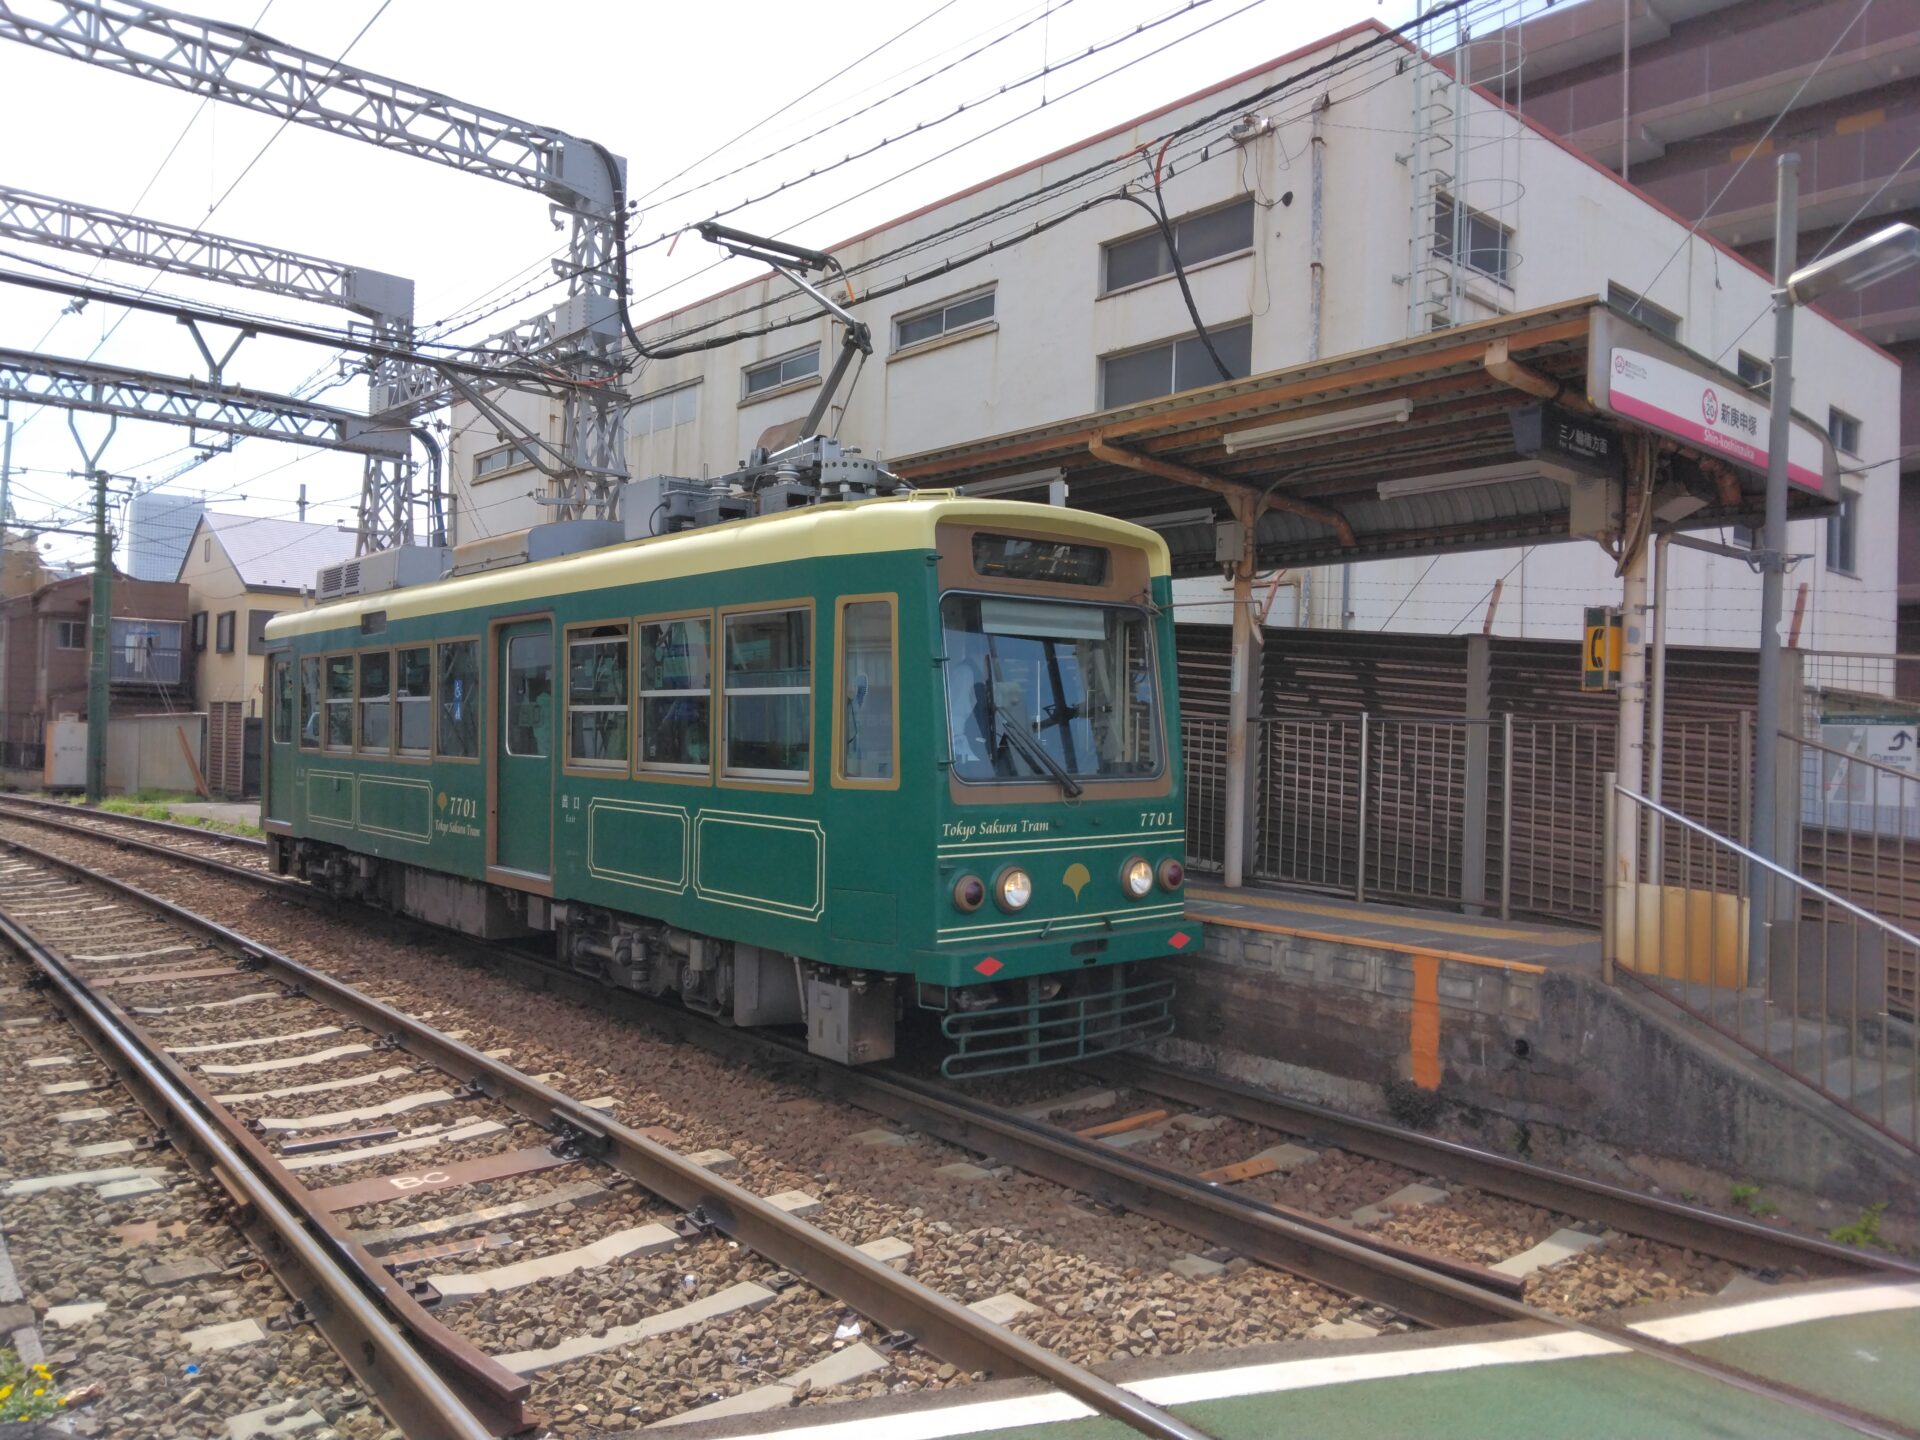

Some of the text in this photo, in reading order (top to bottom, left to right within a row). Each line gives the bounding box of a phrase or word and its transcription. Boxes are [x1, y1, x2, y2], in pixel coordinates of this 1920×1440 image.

[1721, 403, 1757, 436] 新庚申塚
[450, 796, 476, 818] 7701
[942, 818, 1049, 841] Tokyo Sakura Tram
[1141, 812, 1173, 827] 7701
[390, 1171, 451, 1190] BC
